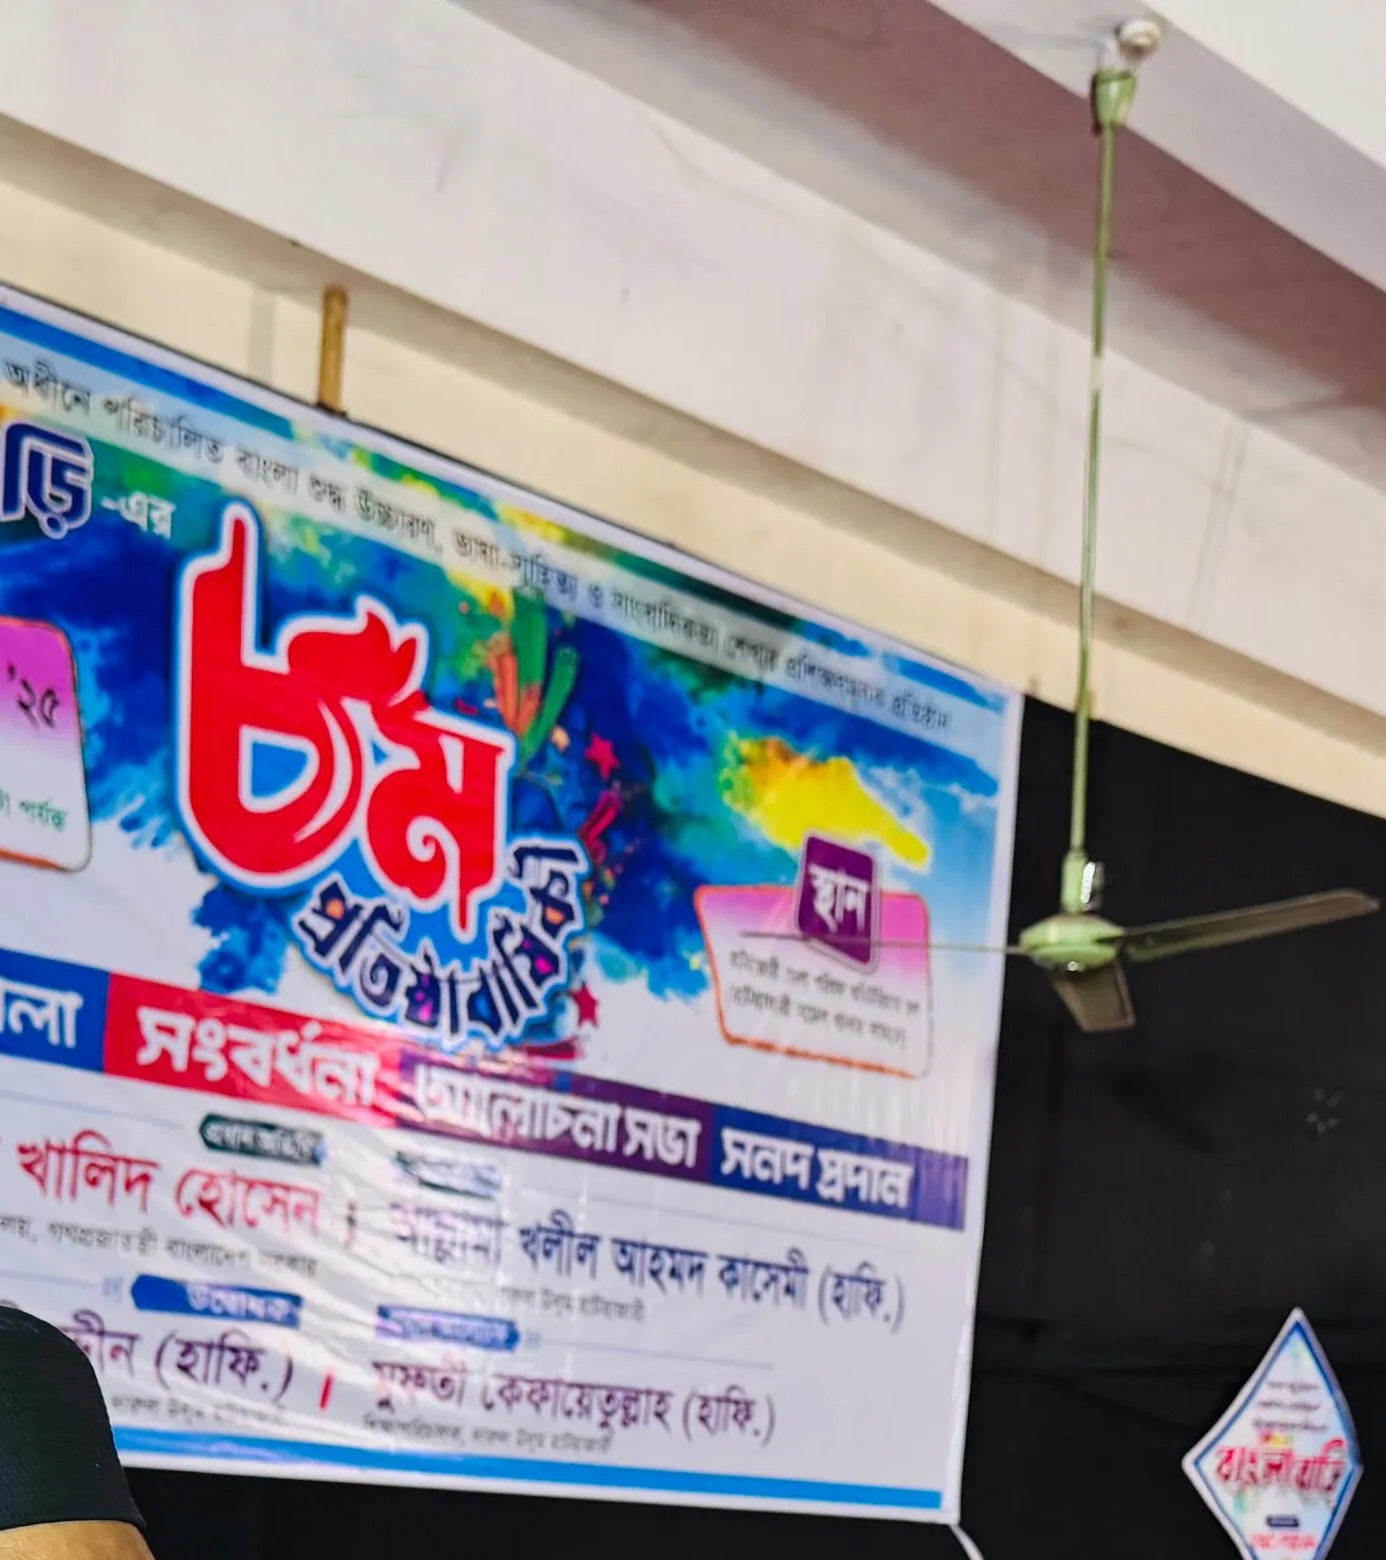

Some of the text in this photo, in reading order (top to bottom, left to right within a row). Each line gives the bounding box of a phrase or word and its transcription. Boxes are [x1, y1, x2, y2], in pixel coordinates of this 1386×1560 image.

[3, 356, 93, 415] অধীনে
[808, 865, 870, 934] স্থান
[135, 1005, 378, 1109] সংবর্ধনা
[623, 1106, 702, 1168] সভা
[720, 1125, 813, 1190] সনদ
[815, 1145, 914, 1209] প্রদান
[17, 1128, 160, 1213] খালিদ
[173, 1165, 323, 1237] হোসেন
[520, 1209, 599, 1282] খলীল
[611, 1235, 710, 1297] আহমদ
[718, 1245, 811, 1313] কাসেমী
[816, 1259, 906, 1334] (হাফি.)
[154, 1328, 296, 1404] (হাফি.)
[680, 1384, 778, 1449] (হাফি.)
